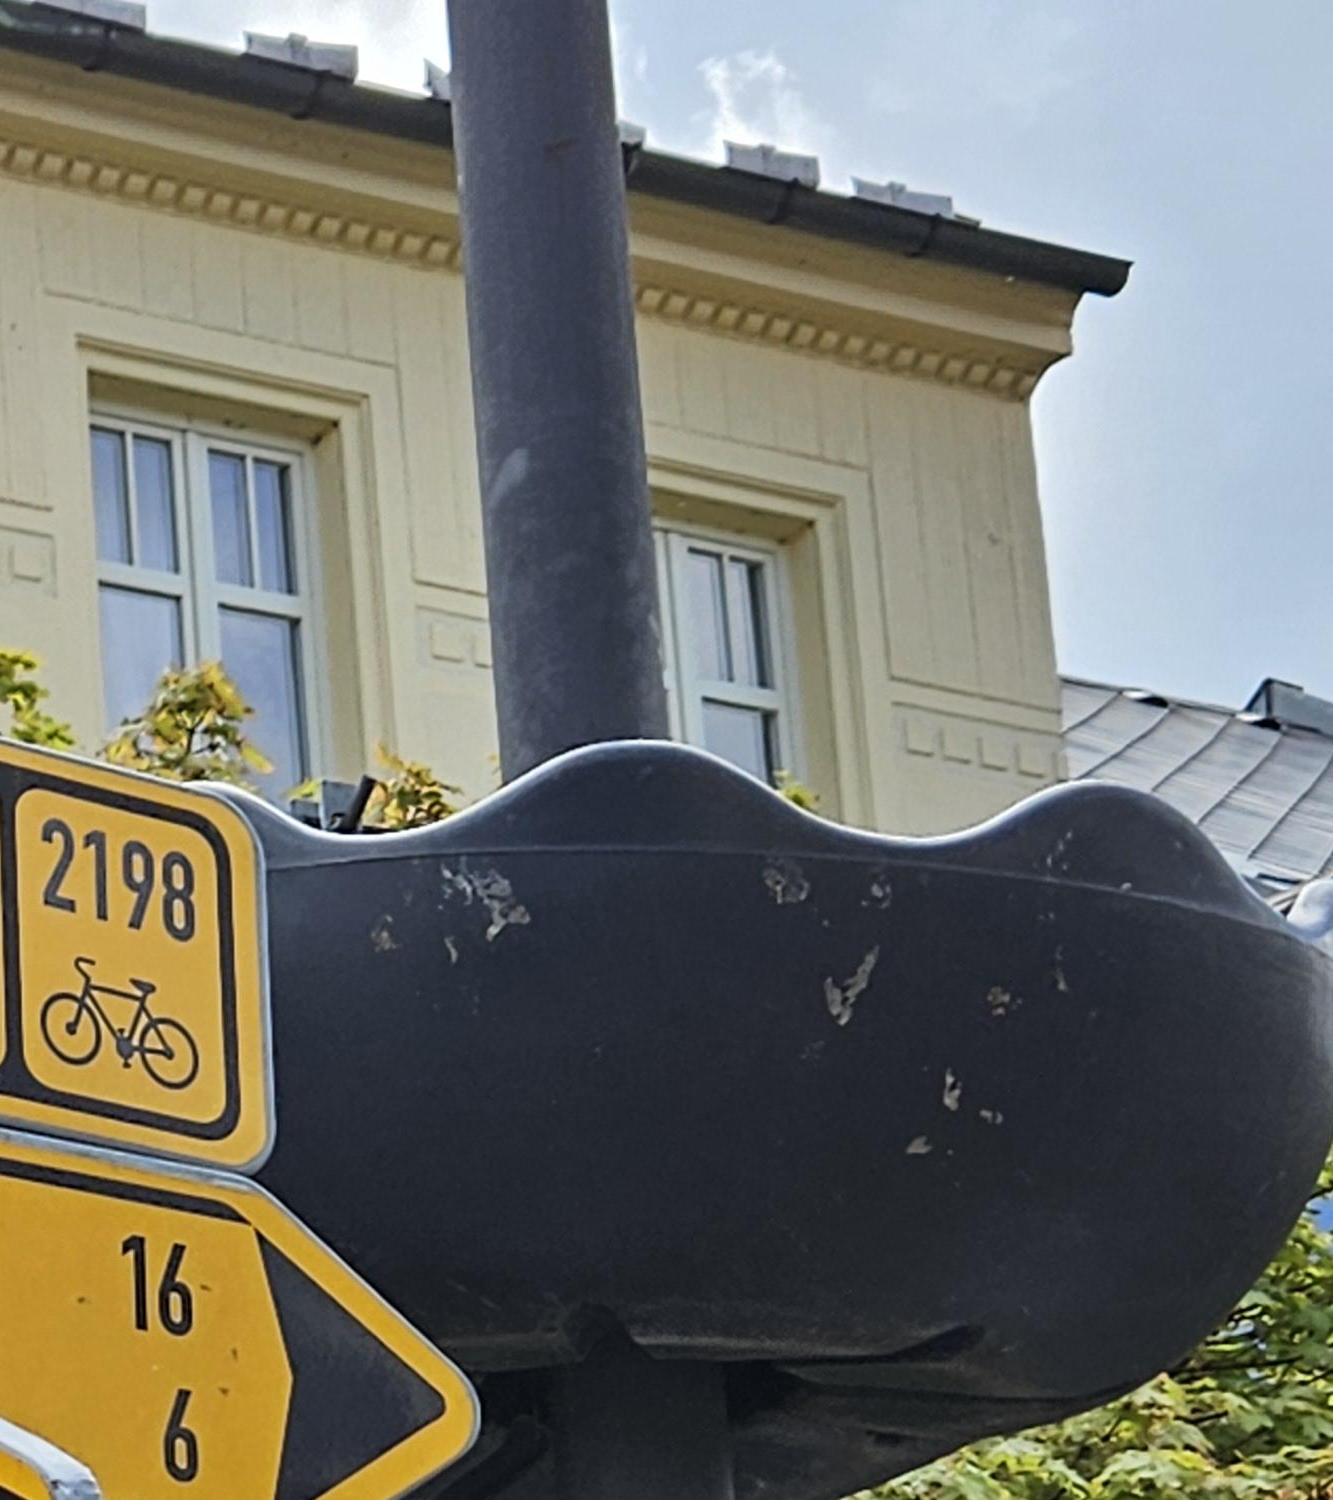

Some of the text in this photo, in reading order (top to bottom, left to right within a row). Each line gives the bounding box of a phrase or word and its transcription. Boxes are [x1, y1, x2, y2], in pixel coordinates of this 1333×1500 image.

[41, 818, 196, 942] 2198
[120, 1234, 194, 1337] 16
[163, 1388, 199, 1483] 6
